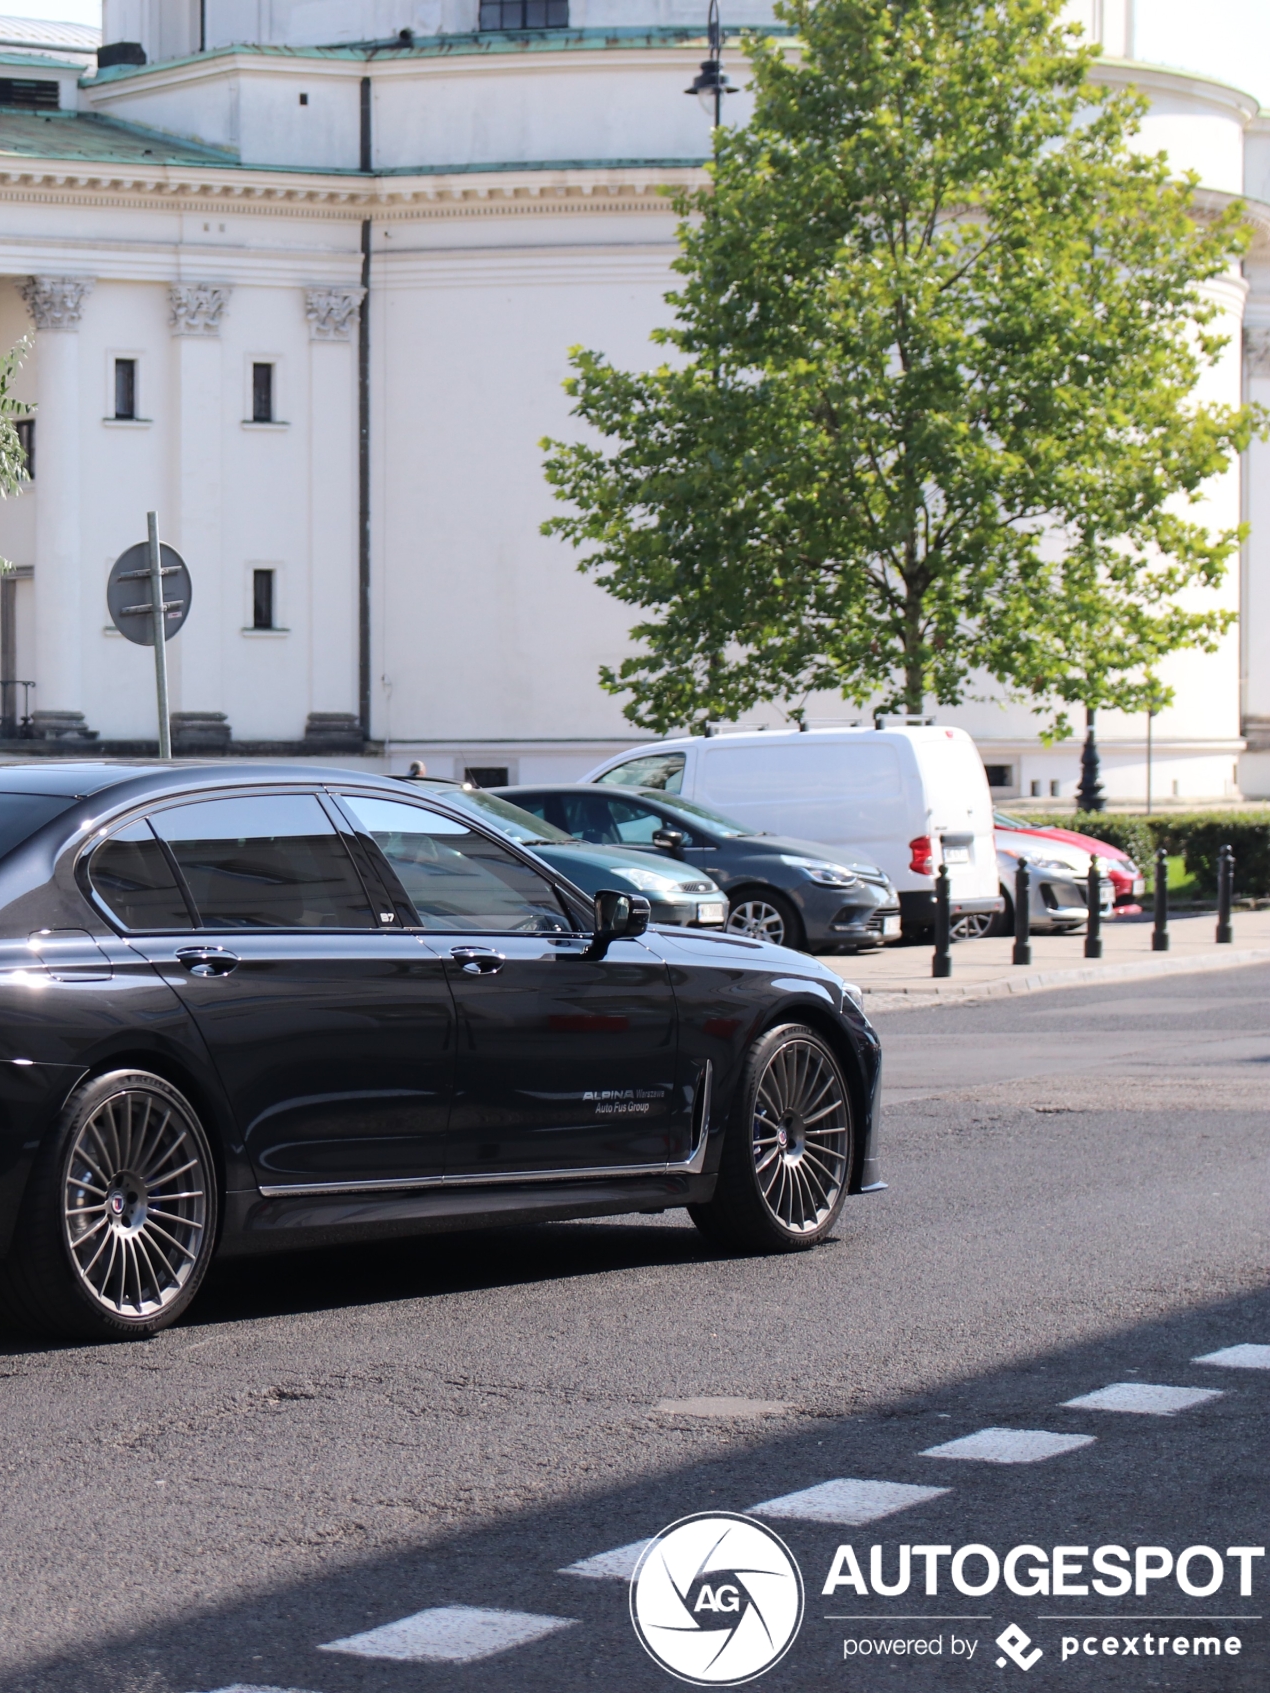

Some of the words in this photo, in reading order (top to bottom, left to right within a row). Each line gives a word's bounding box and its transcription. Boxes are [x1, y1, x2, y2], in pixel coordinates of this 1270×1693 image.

[379, 912, 395, 922] B7
[582, 1089, 635, 1101] ALPINA
[595, 1102, 613, 1113] Auto
[613, 1101, 627, 1113] Fus
[627, 1101, 650, 1114] Group
